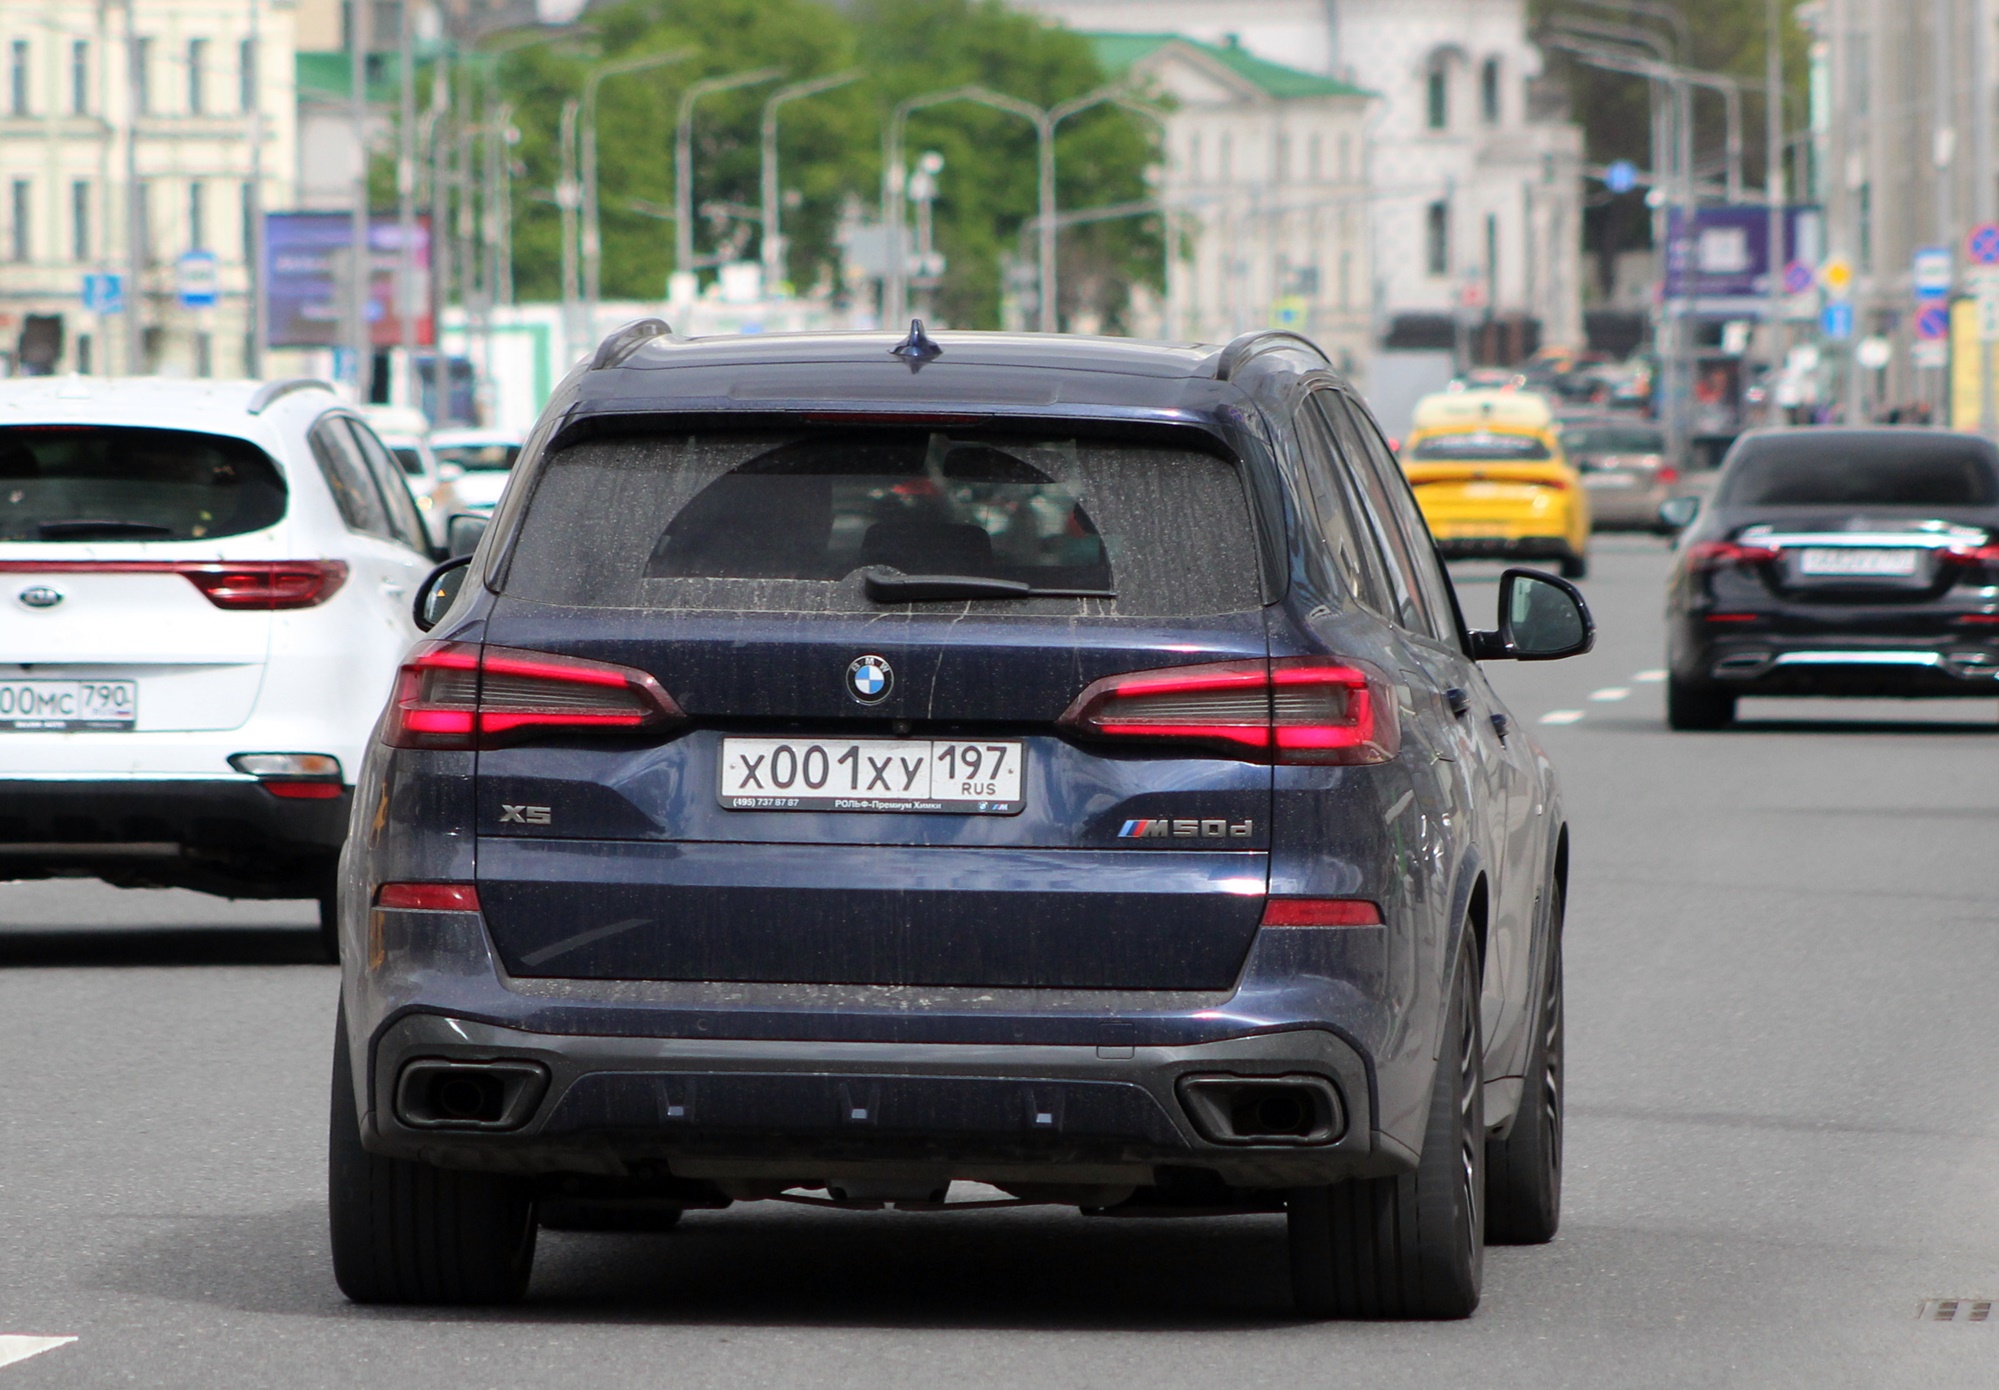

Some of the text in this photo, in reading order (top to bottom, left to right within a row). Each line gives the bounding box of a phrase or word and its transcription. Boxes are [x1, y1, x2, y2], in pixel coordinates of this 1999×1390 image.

[851, 657, 891, 673] BMW
[82, 685, 126, 707] 790
[937, 745, 1008, 780] 197
[961, 782, 997, 796] RUS
[732, 797, 756, 808] (495)
[756, 797, 774, 807] 737
[834, 799, 942, 811] РОЛЬФ-Премиум Химки
[499, 804, 552, 825] X5
[1138, 819, 1253, 838] M50d
